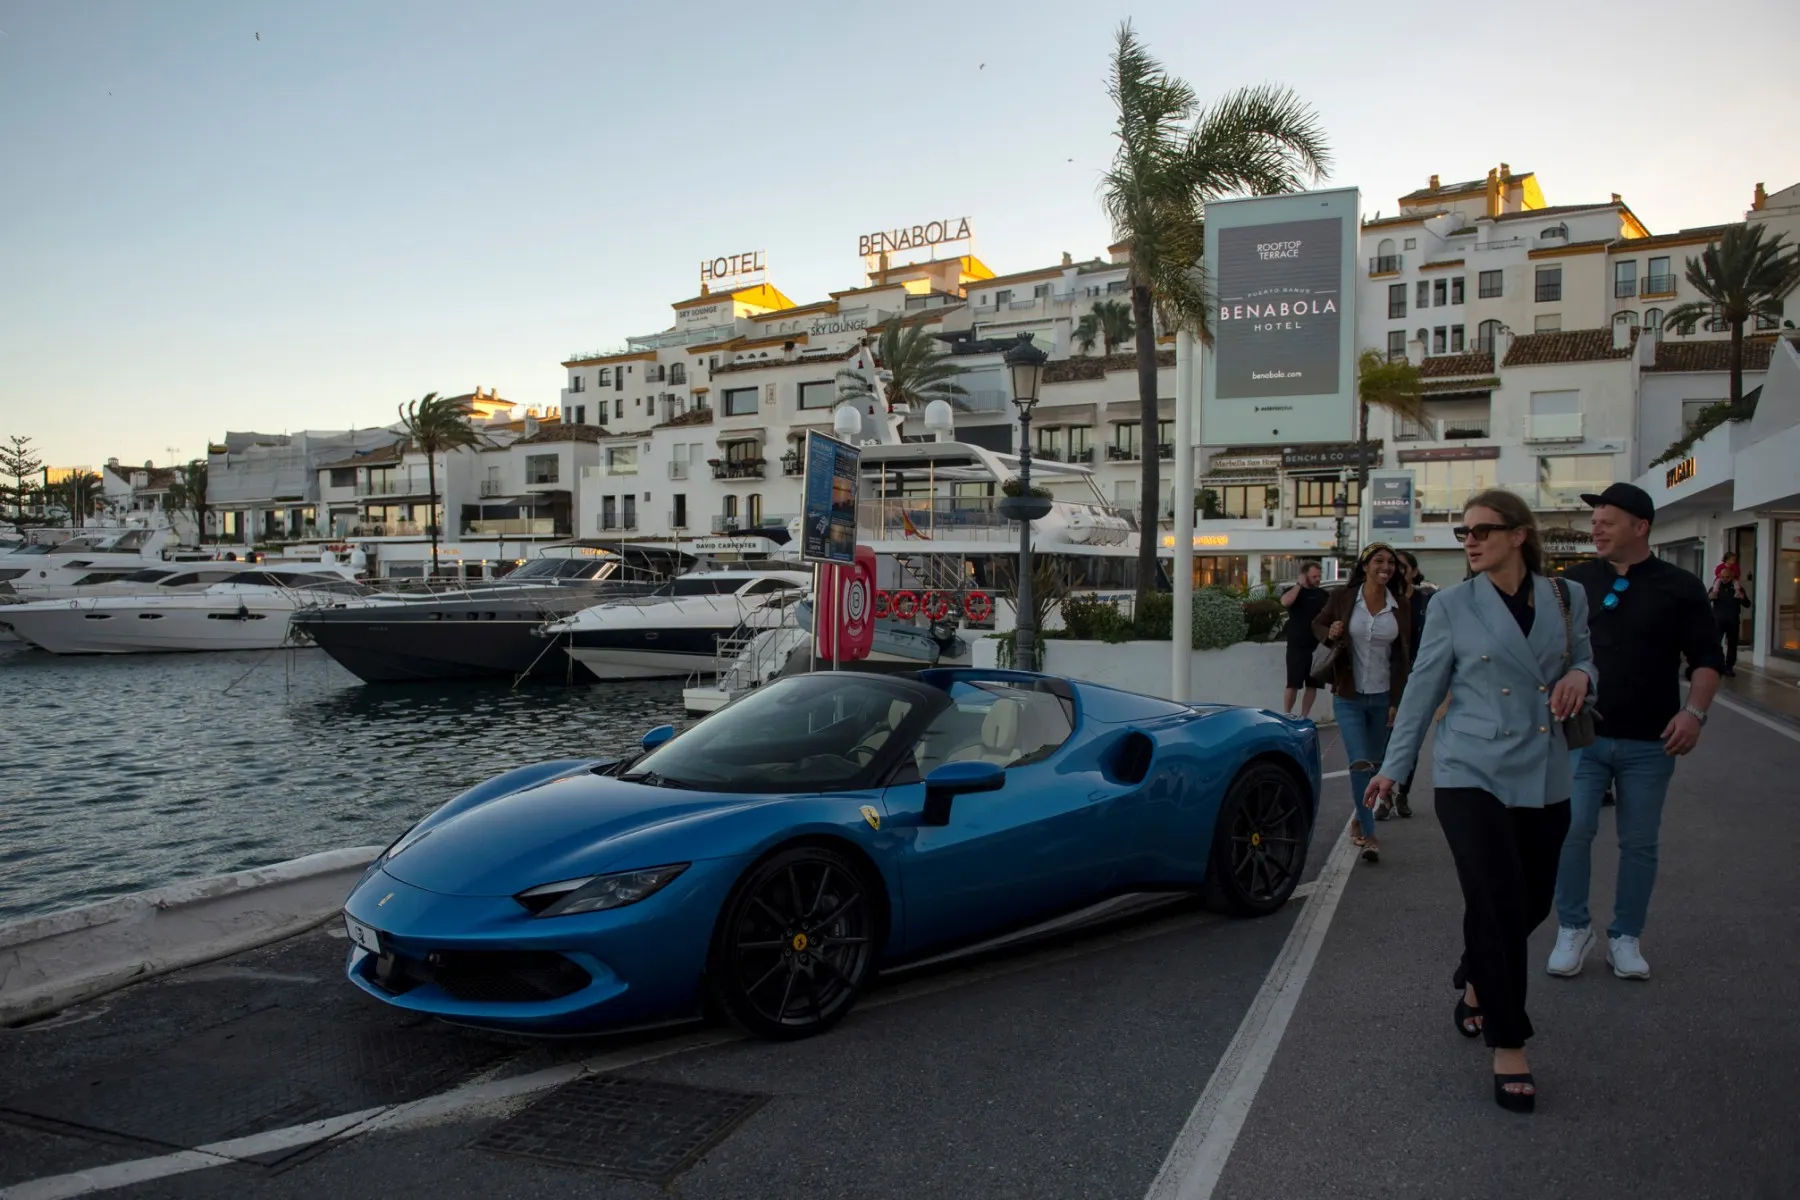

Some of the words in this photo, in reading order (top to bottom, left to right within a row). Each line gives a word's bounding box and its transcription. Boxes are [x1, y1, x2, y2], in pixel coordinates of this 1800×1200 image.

[859, 217, 971, 257] BENABOLA
[1257, 240, 1302, 252] ROOFTOP
[1259, 249, 1300, 260] TERRACE
[701, 251, 764, 281] HOTEL
[1247, 288, 1280, 298] PUERTO
[692, 305, 718, 317] LOUNGE
[1220, 299, 1337, 321] BENABOLA
[811, 325, 828, 337] SKY
[829, 320, 866, 334] LOUNGE
[1254, 322, 1303, 332] HOTEL
[1252, 370, 1302, 380] benabola.com
[1285, 454, 1317, 463] BENCH
[1320, 454, 1327, 462] &
[1330, 452, 1344, 461] CO
[718, 542, 757, 550] CARPENTER
